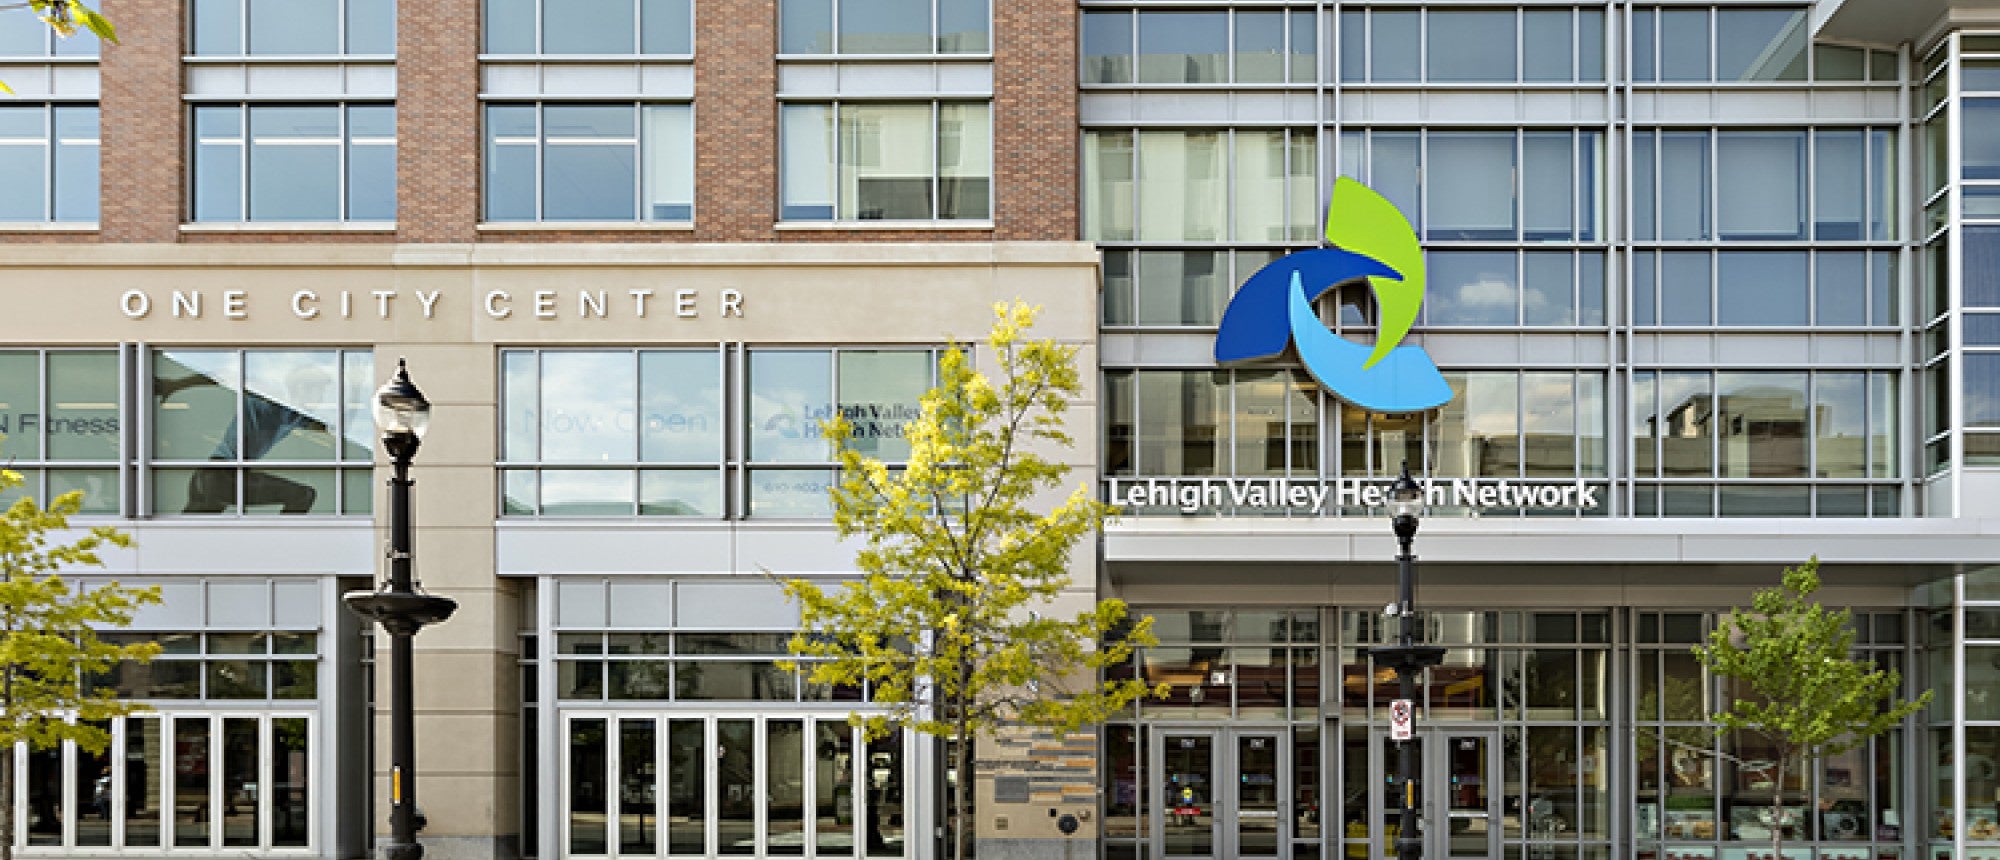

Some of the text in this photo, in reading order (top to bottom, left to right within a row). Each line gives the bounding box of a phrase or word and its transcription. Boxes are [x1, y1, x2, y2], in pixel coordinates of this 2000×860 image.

[120, 288, 745, 320] ONE CITY CENTER
[1110, 477, 1223, 512] Lehigh
[1226, 477, 1328, 513] Valley
[1452, 477, 1599, 506] Network
